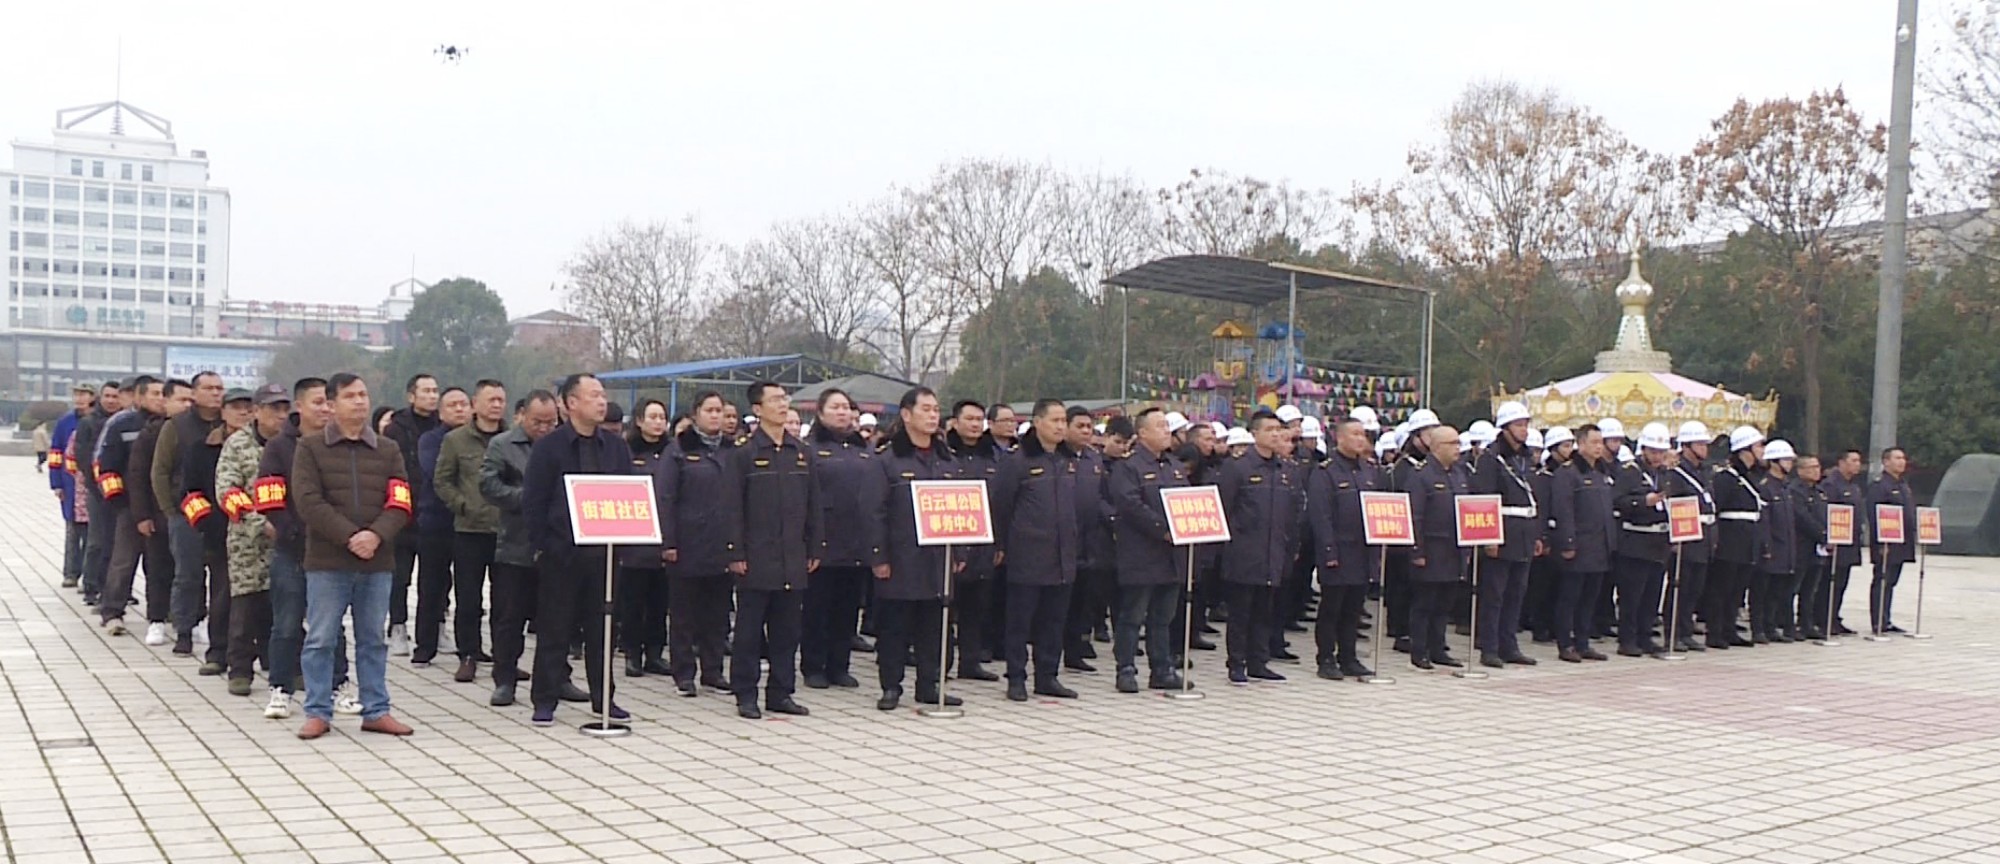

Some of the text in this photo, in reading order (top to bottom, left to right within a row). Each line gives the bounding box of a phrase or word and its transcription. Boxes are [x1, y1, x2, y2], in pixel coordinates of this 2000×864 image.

[257, 483, 286, 503] 整治
[920, 492, 981, 512] 白云湖公园
[581, 499, 651, 520] 街道社区
[929, 513, 978, 532] 事务中心
[1175, 515, 1221, 534] 事务中心
[1465, 512, 1496, 528] 局机关
